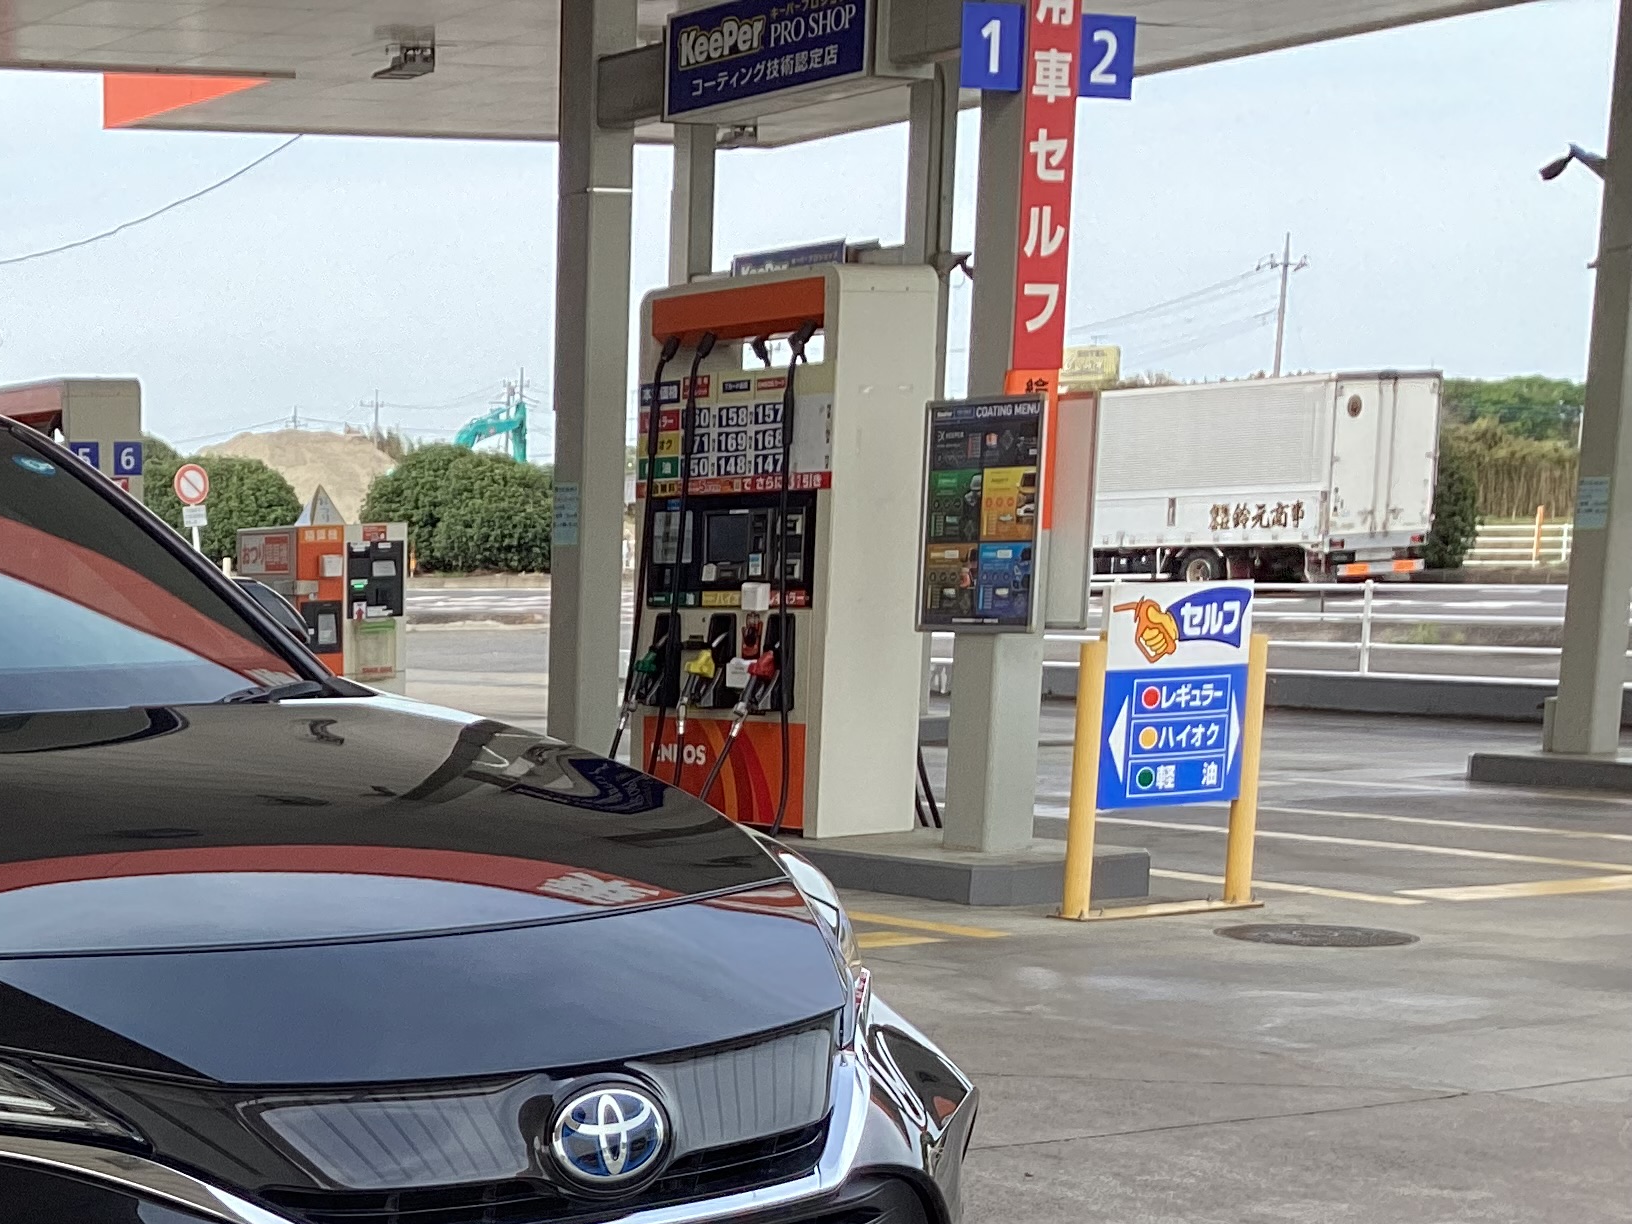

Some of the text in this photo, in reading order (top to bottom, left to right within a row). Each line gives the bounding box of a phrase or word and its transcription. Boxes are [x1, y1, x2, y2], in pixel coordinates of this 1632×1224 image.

[771, 0, 845, 19] キーパープロ
[679, 4, 856, 70] KeePer PRO SHOP
[981, 19, 1001, 74] 1
[1090, 29, 1118, 84] 2
[692, 44, 839, 96] コーティング技術認定店
[720, 407, 747, 427] 158
[756, 404, 783, 424] 157
[976, 404, 1013, 418] COATING
[1014, 402, 1041, 415] MENU
[720, 430, 746, 450] 169
[756, 429, 783, 449] 168
[120, 447, 136, 470] 6
[719, 457, 746, 476] 148
[756, 455, 783, 473] 147
[1180, 600, 1241, 637] セルフ
[1160, 683, 1223, 709] レギュラー
[1158, 722, 1219, 749] ハイオク
[1155, 762, 1218, 790] 軽油
